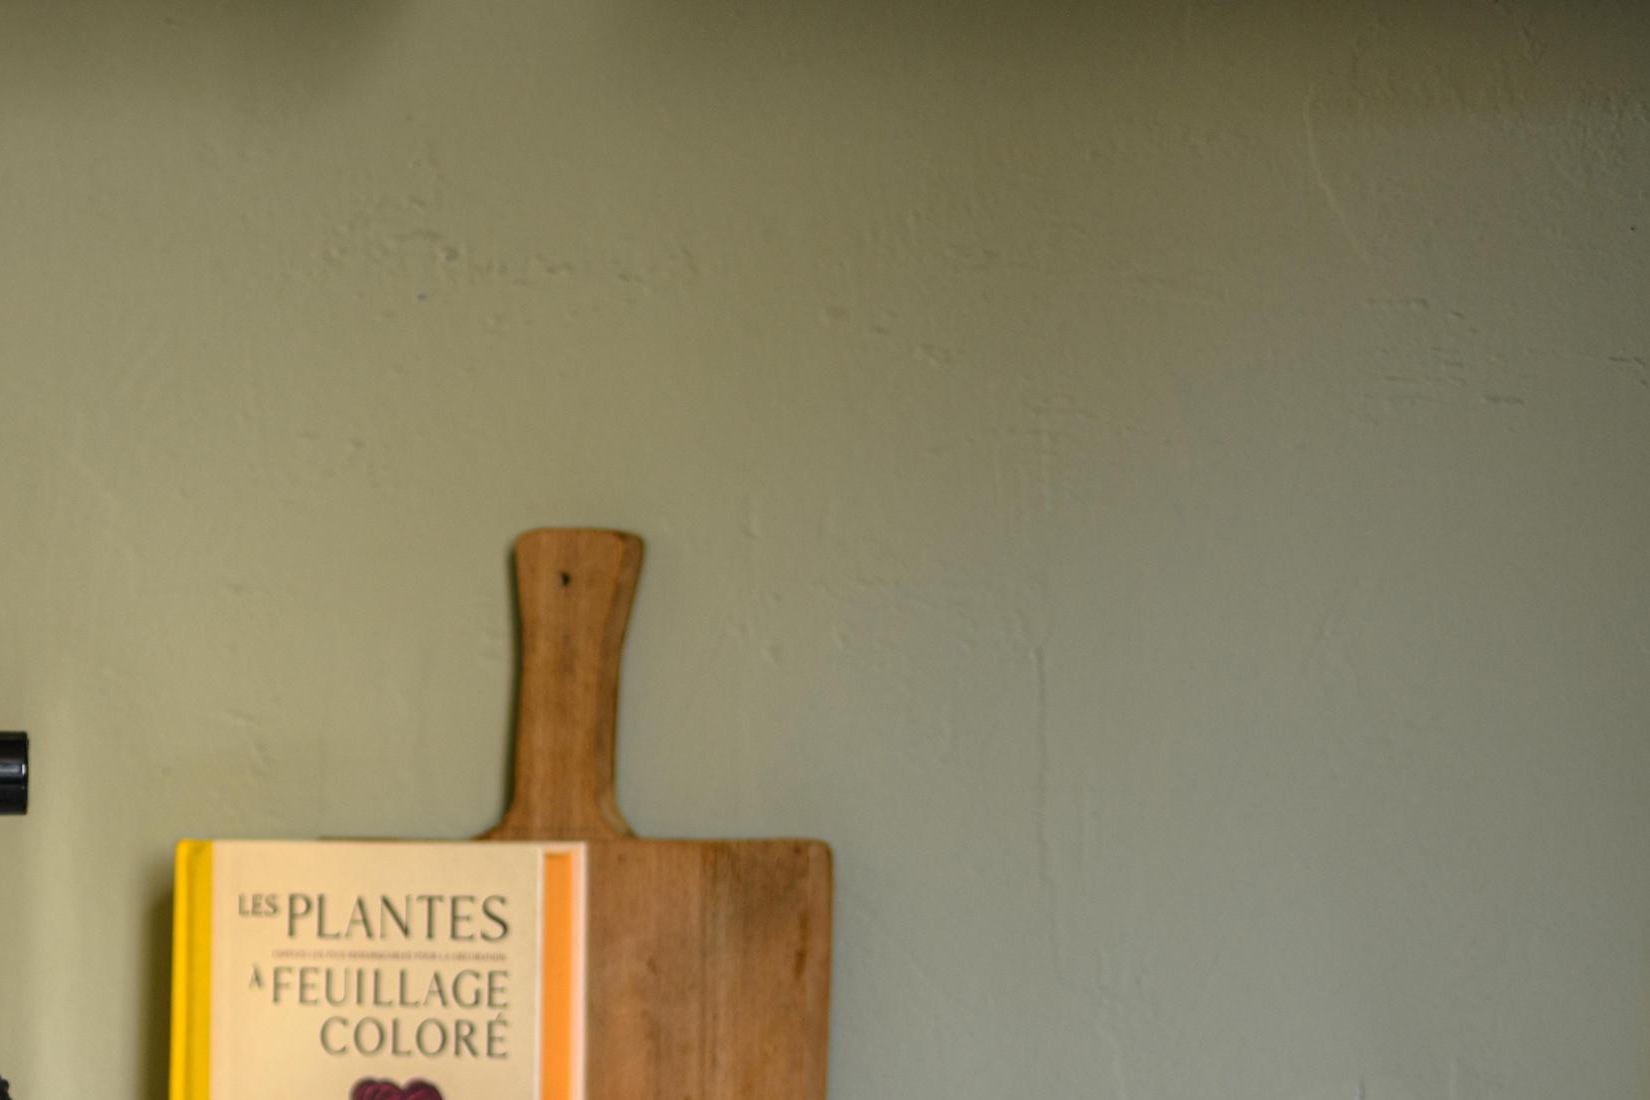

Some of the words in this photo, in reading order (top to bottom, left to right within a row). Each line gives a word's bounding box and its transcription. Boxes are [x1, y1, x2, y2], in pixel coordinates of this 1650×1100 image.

[238, 893, 280, 917] LES
[287, 892, 510, 943] PLANTES
[272, 965, 510, 1010] FEUILLAGE
[319, 1011, 510, 1060] COLORÉ
